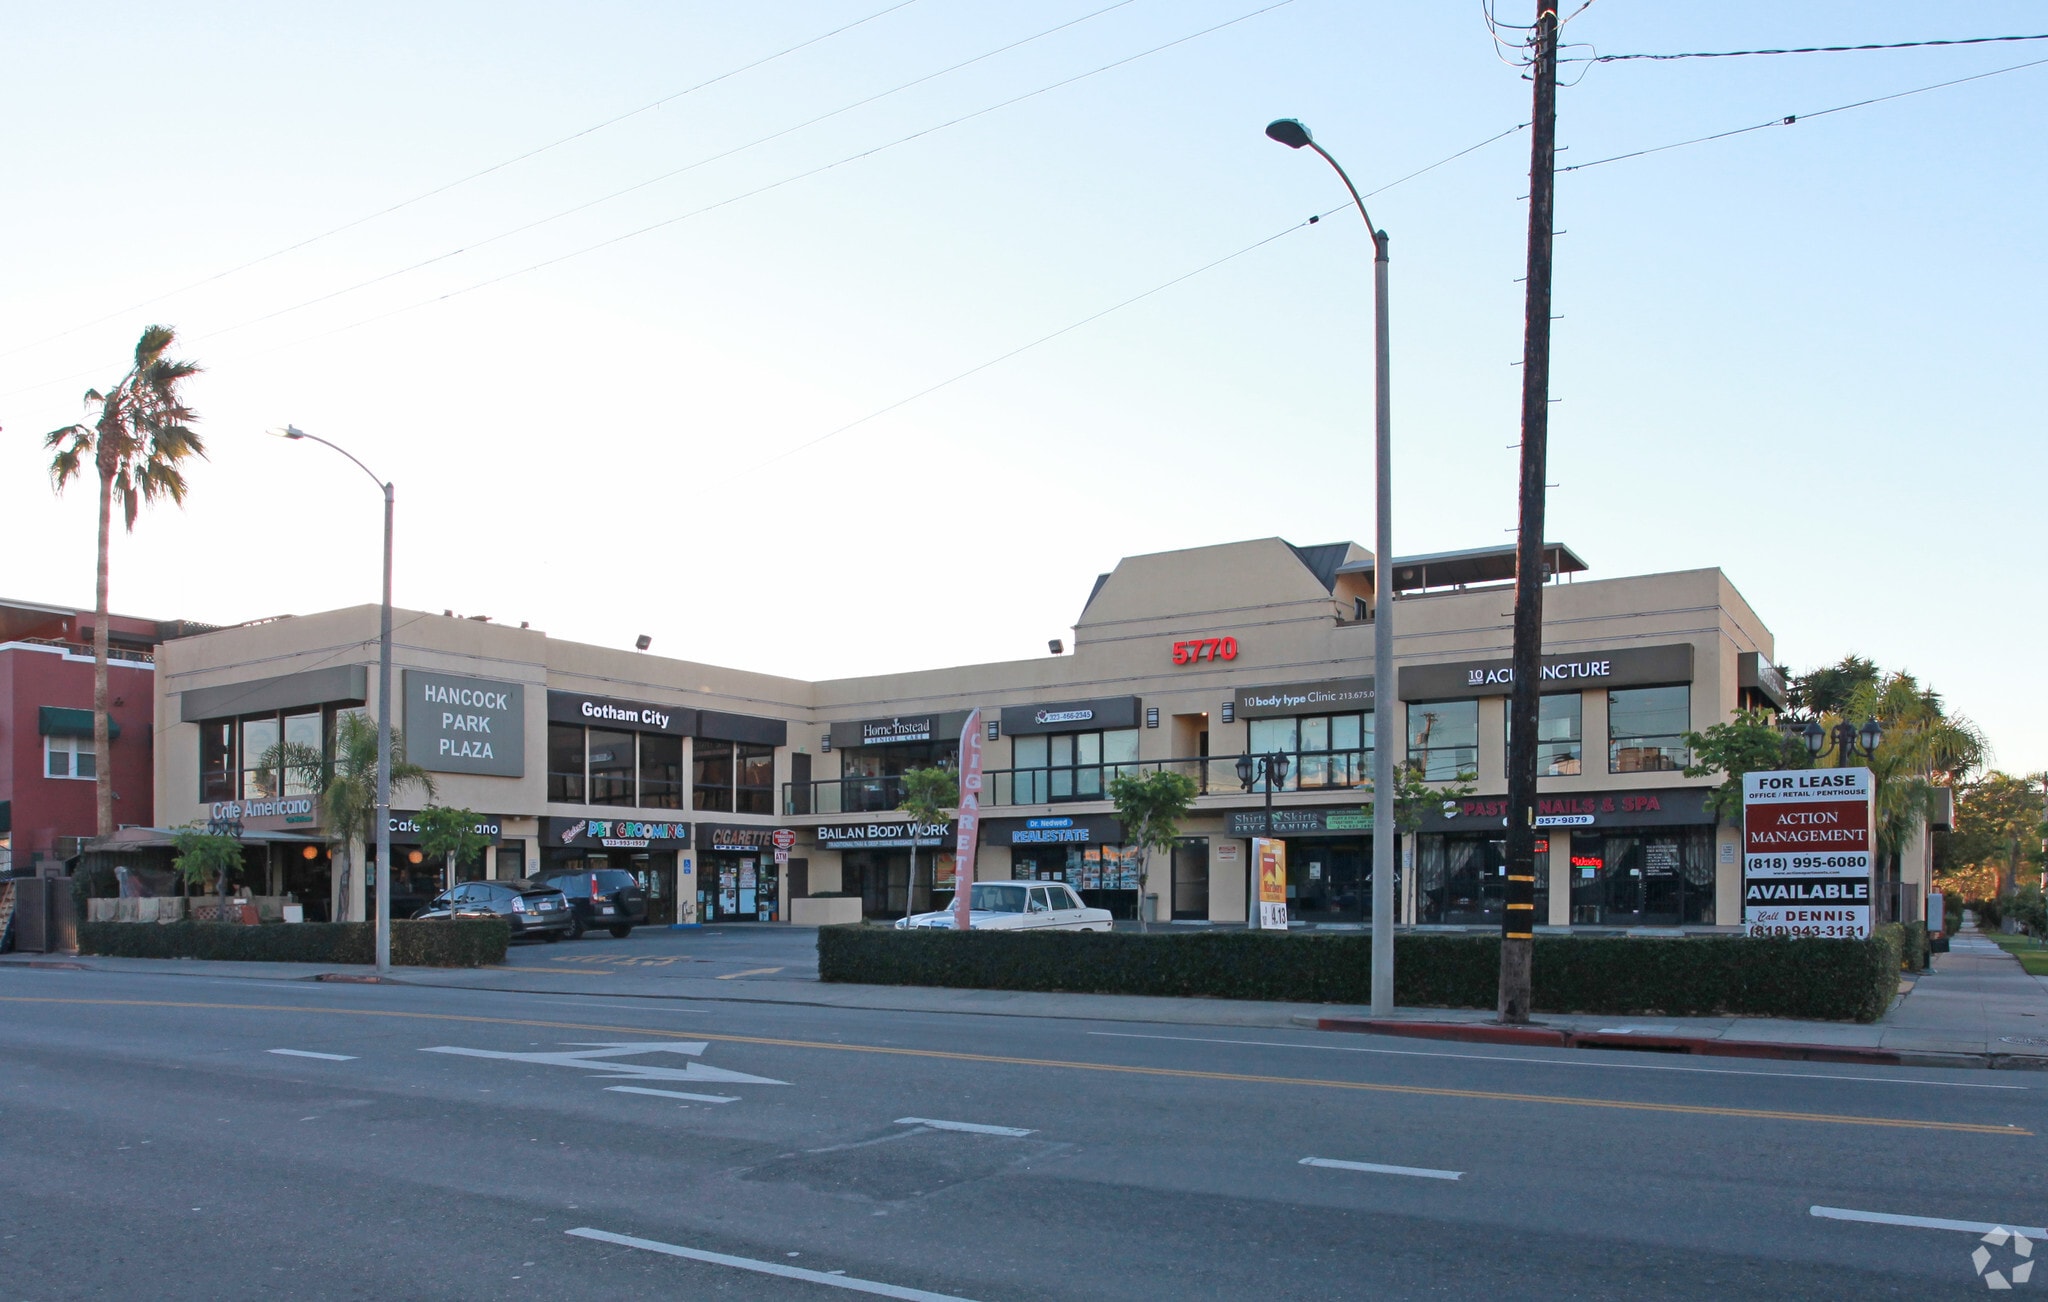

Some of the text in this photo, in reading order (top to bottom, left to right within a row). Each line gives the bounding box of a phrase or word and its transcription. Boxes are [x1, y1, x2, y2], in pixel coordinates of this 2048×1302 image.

[1172, 636, 1238, 665] 5770
[1469, 661, 1610, 684] 10 ACNCTURE
[425, 685, 507, 710] HANCOCK
[1244, 690, 1375, 707] 10 body type Clinic 213.675.0
[443, 712, 491, 733] PARK
[582, 702, 669, 729] Gotham City
[864, 724, 892, 736] Home
[440, 738, 493, 759] PLAZA
[1759, 775, 1856, 789] FOR LEASE
[213, 798, 313, 819] Cafe Americano
[1463, 796, 1660, 817] PAST NAILS & SPA
[1283, 812, 1318, 821] Skirts
[1777, 811, 1838, 825] ACTION
[587, 821, 685, 839] PET GROOMING
[818, 823, 949, 840] BAILAN BODY WORK
[1259, 823, 1317, 831] CEANING
[712, 829, 772, 846] CIGARETTE
[1751, 829, 1866, 843] MANAGEMENT
[776, 852, 787, 860] ATM
[1571, 856, 1603, 869] Waxing
[1748, 856, 1867, 871] (818) 995-6080
[1747, 884, 1868, 899] AVAILABLE
[1758, 911, 1855, 922] Call DENNIS
